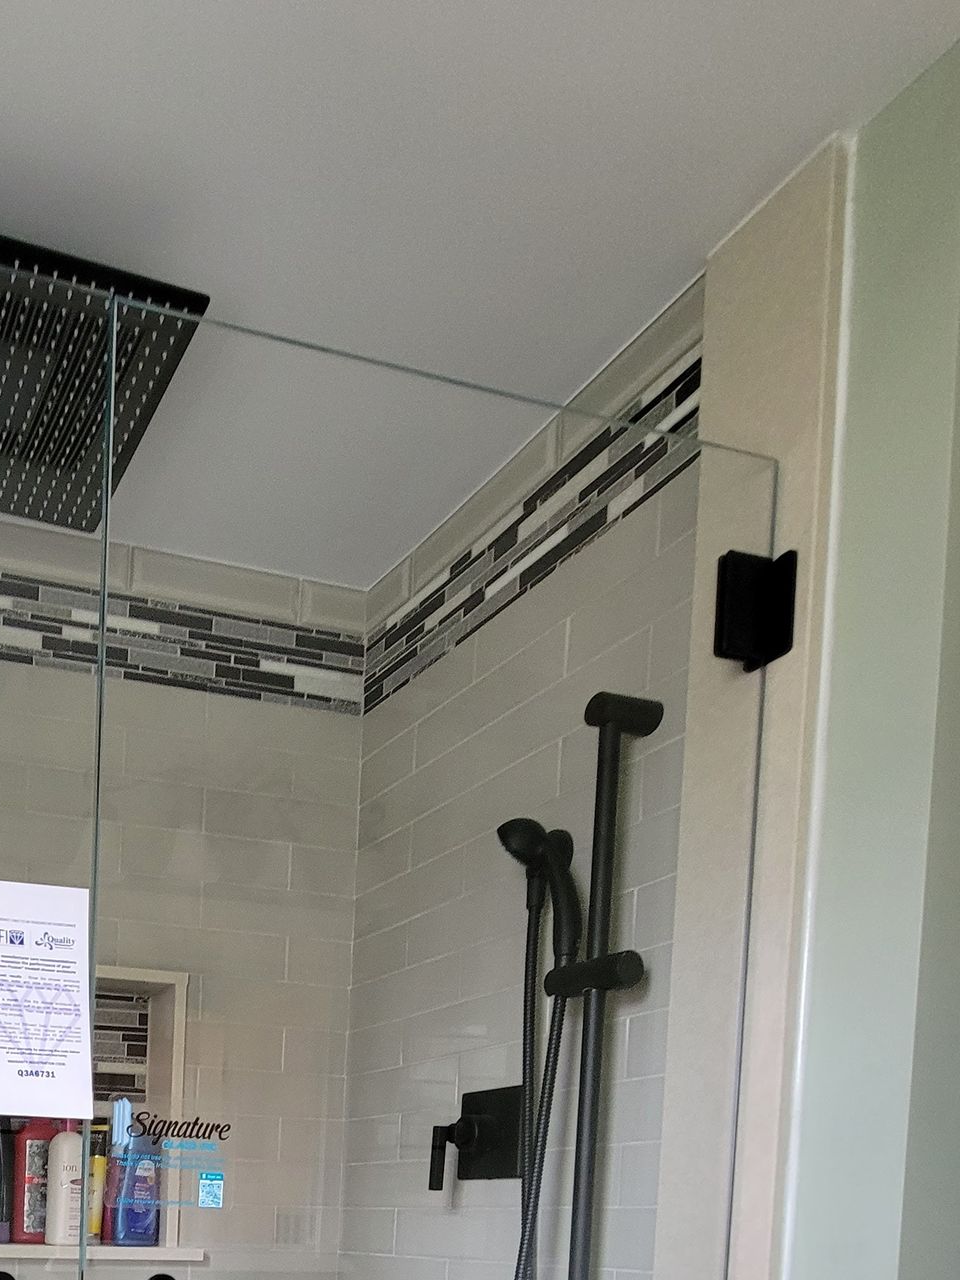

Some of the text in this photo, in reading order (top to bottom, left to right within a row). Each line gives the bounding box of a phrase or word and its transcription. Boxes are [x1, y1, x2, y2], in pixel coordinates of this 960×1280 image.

[47, 935, 75, 947] Quality
[17, 1069, 56, 1079] Q3A6731
[126, 1111, 232, 1146] Signature
[62, 1163, 77, 1172] ion
